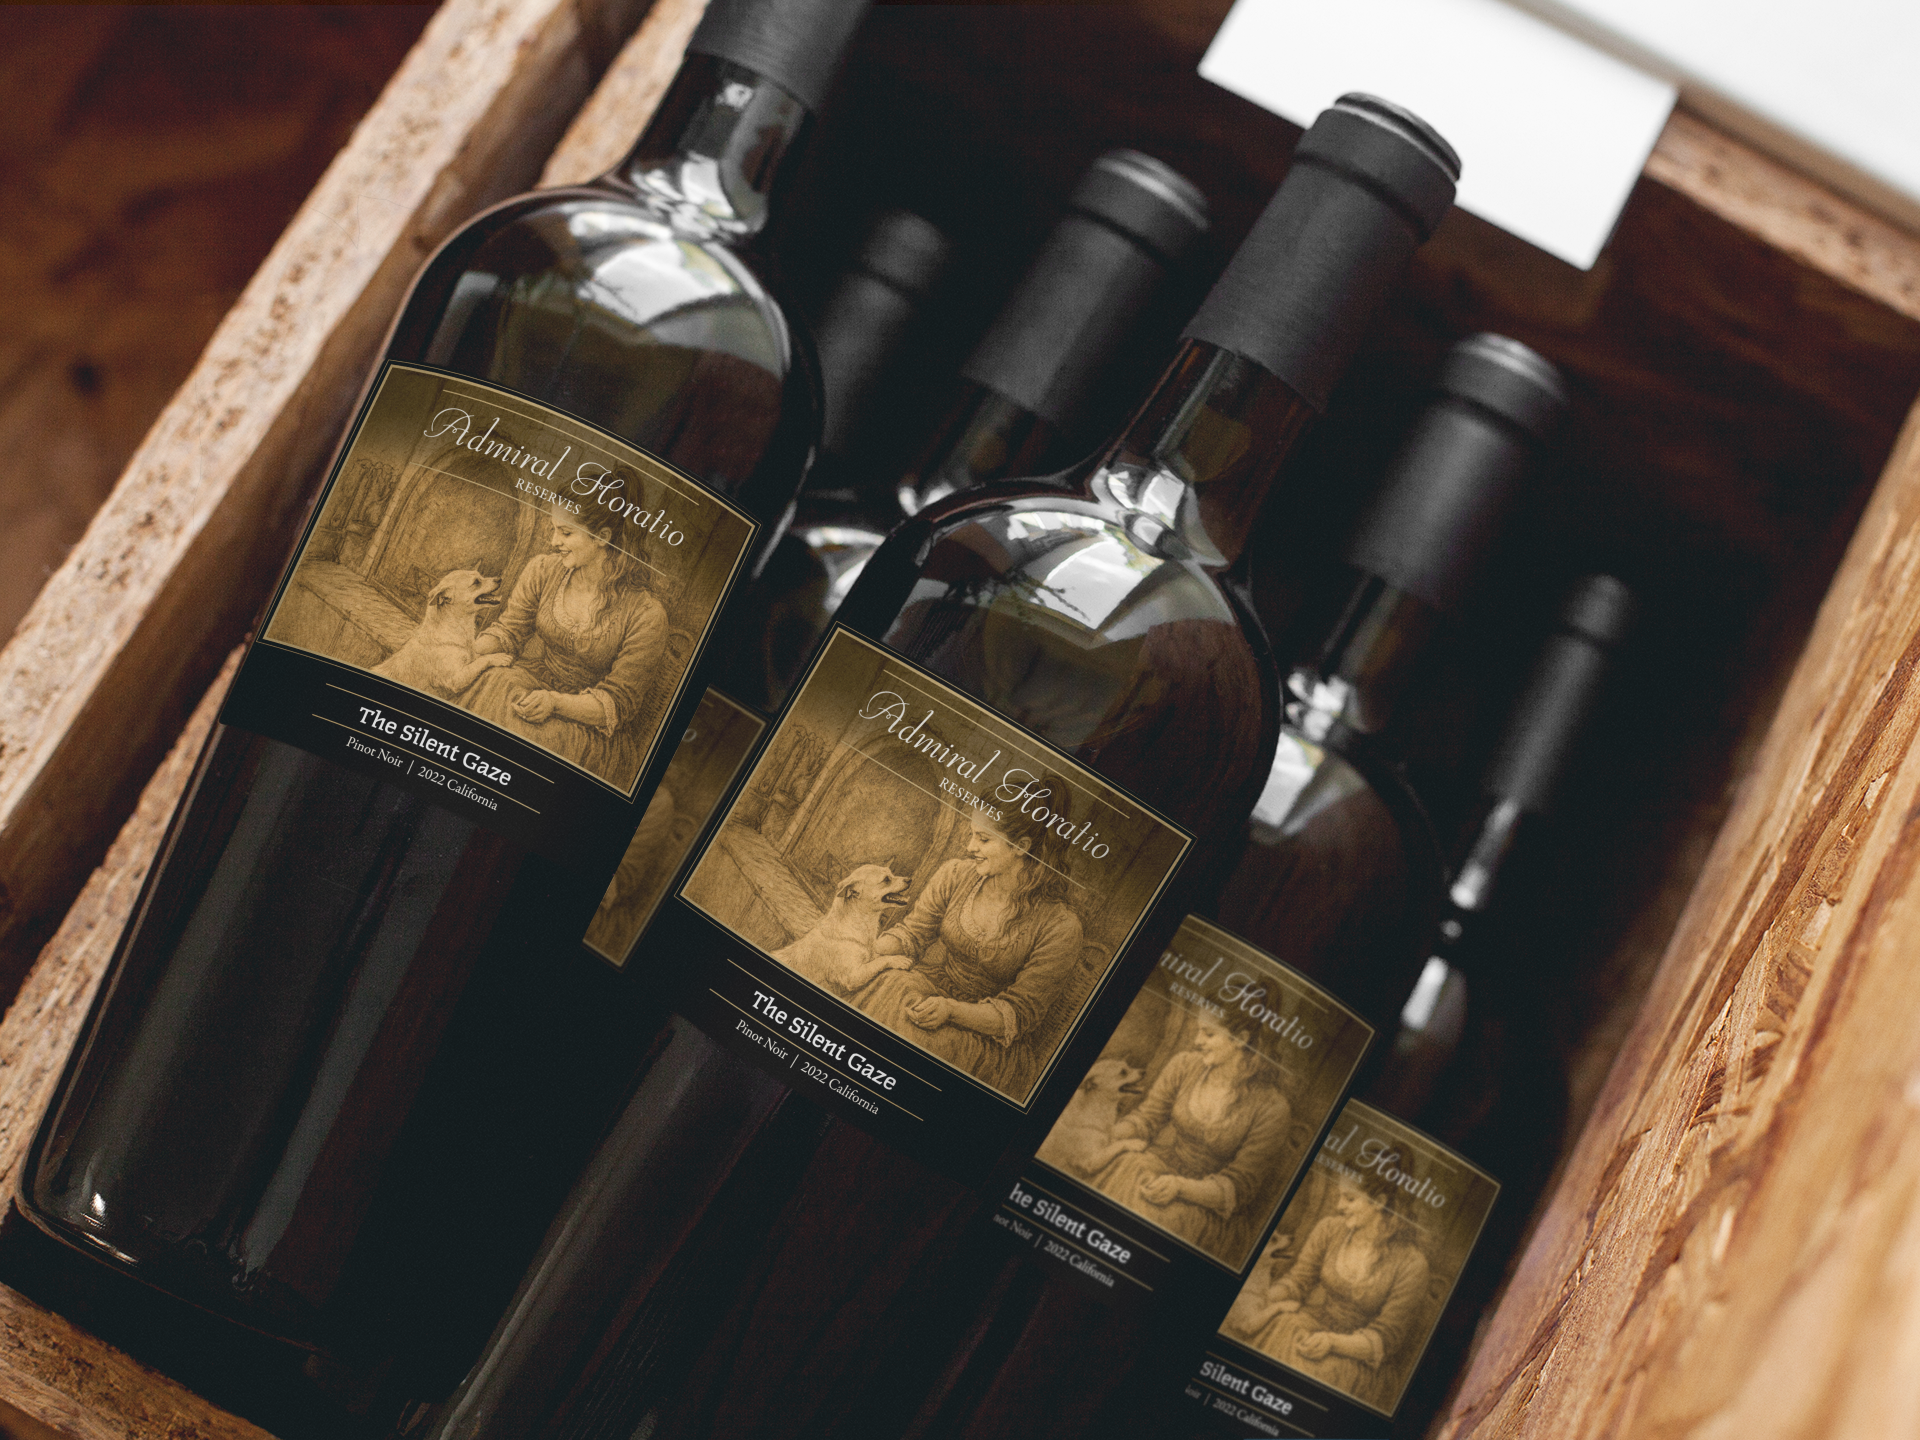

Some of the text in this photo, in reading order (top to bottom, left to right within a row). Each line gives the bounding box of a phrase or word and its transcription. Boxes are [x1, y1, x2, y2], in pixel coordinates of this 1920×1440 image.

[423, 407, 685, 547] Admiral Horatio
[514, 477, 582, 515] RESERVES
[345, 736, 376, 757] Pinot
[376, 748, 404, 769] Noir
[417, 766, 446, 787] 2022
[446, 779, 499, 811] California
[359, 706, 512, 786] The Silent Gaze
[858, 690, 1110, 859] Admiral Horatio
[938, 777, 1004, 822] RESERVES
[1169, 981, 1227, 1019] RESERVES
[1218, 971, 1314, 1050] Horatio
[735, 1018, 764, 1045] Pinot
[763, 1036, 789, 1060] Noir
[800, 1061, 829, 1085] 2022
[828, 1078, 880, 1116] California
[752, 990, 897, 1091] The Silent Gaze
[1355, 1138, 1446, 1209] Horatio
[1009, 1219, 1034, 1240] Noir
[1043, 1240, 1070, 1262] 2022
[1069, 1253, 1115, 1288] California
[1032, 1198, 1088, 1239] Silent
[1086, 1229, 1132, 1265] Gaze
[1200, 1360, 1294, 1416] Silent Gaze
[1212, 1397, 1238, 1417] 2022
[1236, 1408, 1280, 1438] California
